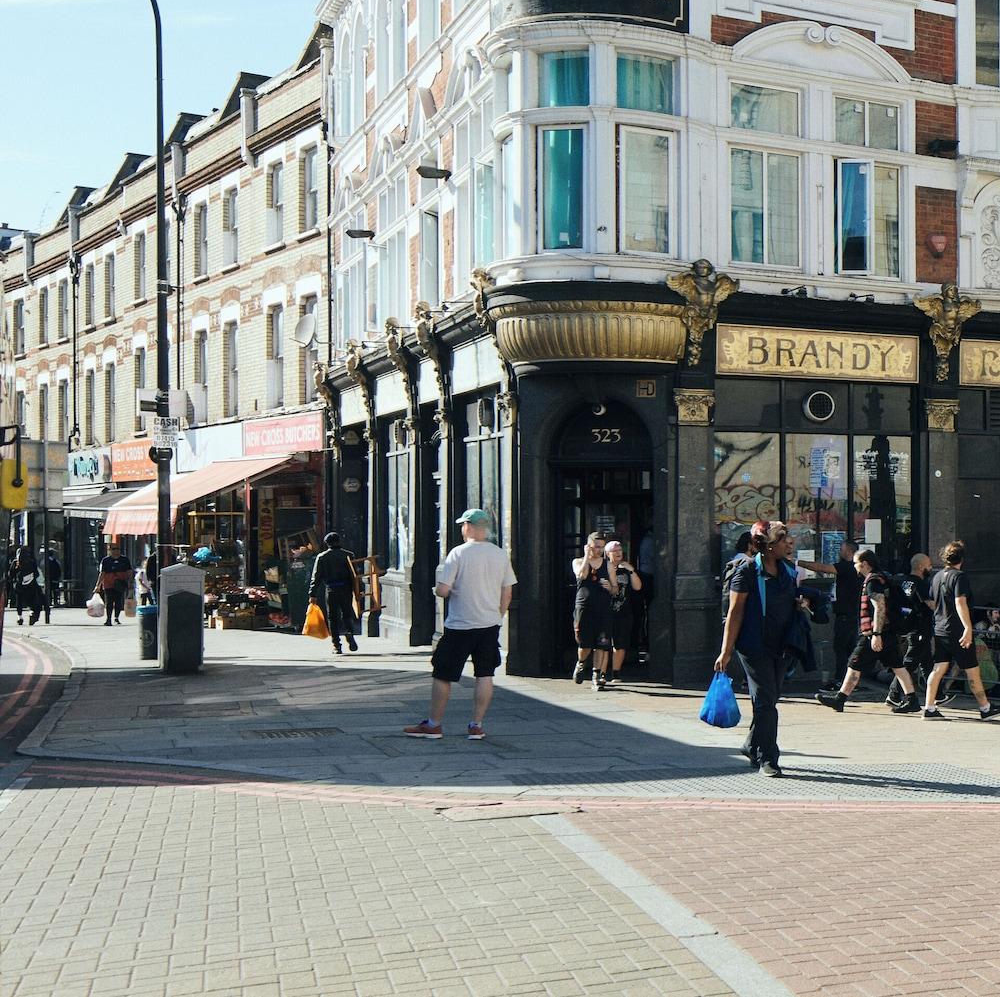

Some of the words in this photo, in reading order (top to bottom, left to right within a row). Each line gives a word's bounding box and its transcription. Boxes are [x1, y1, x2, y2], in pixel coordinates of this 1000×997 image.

[747, 336, 895, 372] BRANDY
[153, 417, 178, 426] CASH
[245, 431, 260, 447] NEW
[260, 427, 284, 446] CROSS
[285, 424, 320, 443] BUTCHERS
[591, 428, 621, 444] 323
